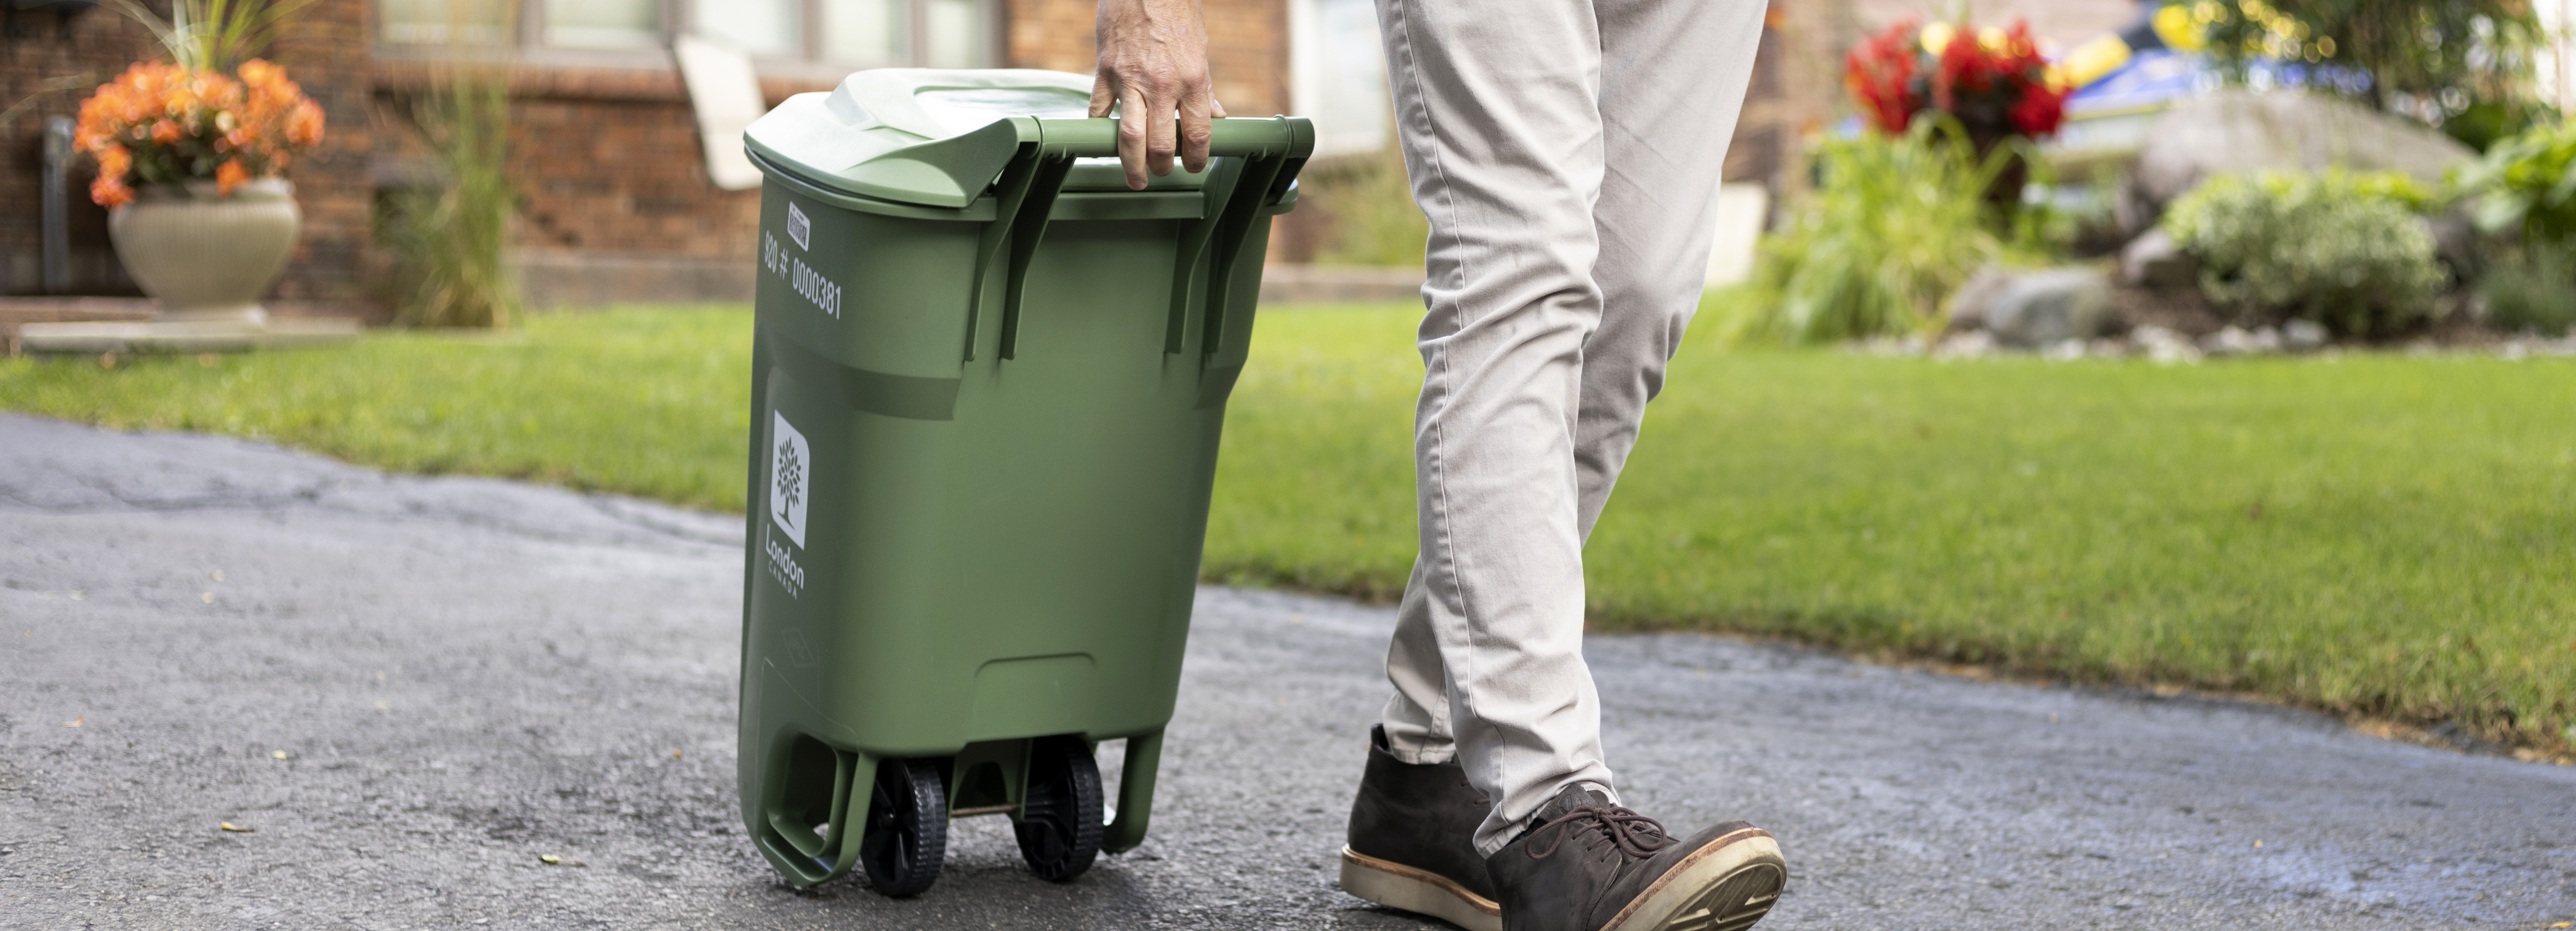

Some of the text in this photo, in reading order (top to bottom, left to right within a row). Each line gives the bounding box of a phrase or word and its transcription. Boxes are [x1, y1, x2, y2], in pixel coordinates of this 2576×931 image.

[765, 230, 841, 320] 920 # 0000381
[766, 523, 804, 590] London
[768, 560, 797, 601] CANADA
